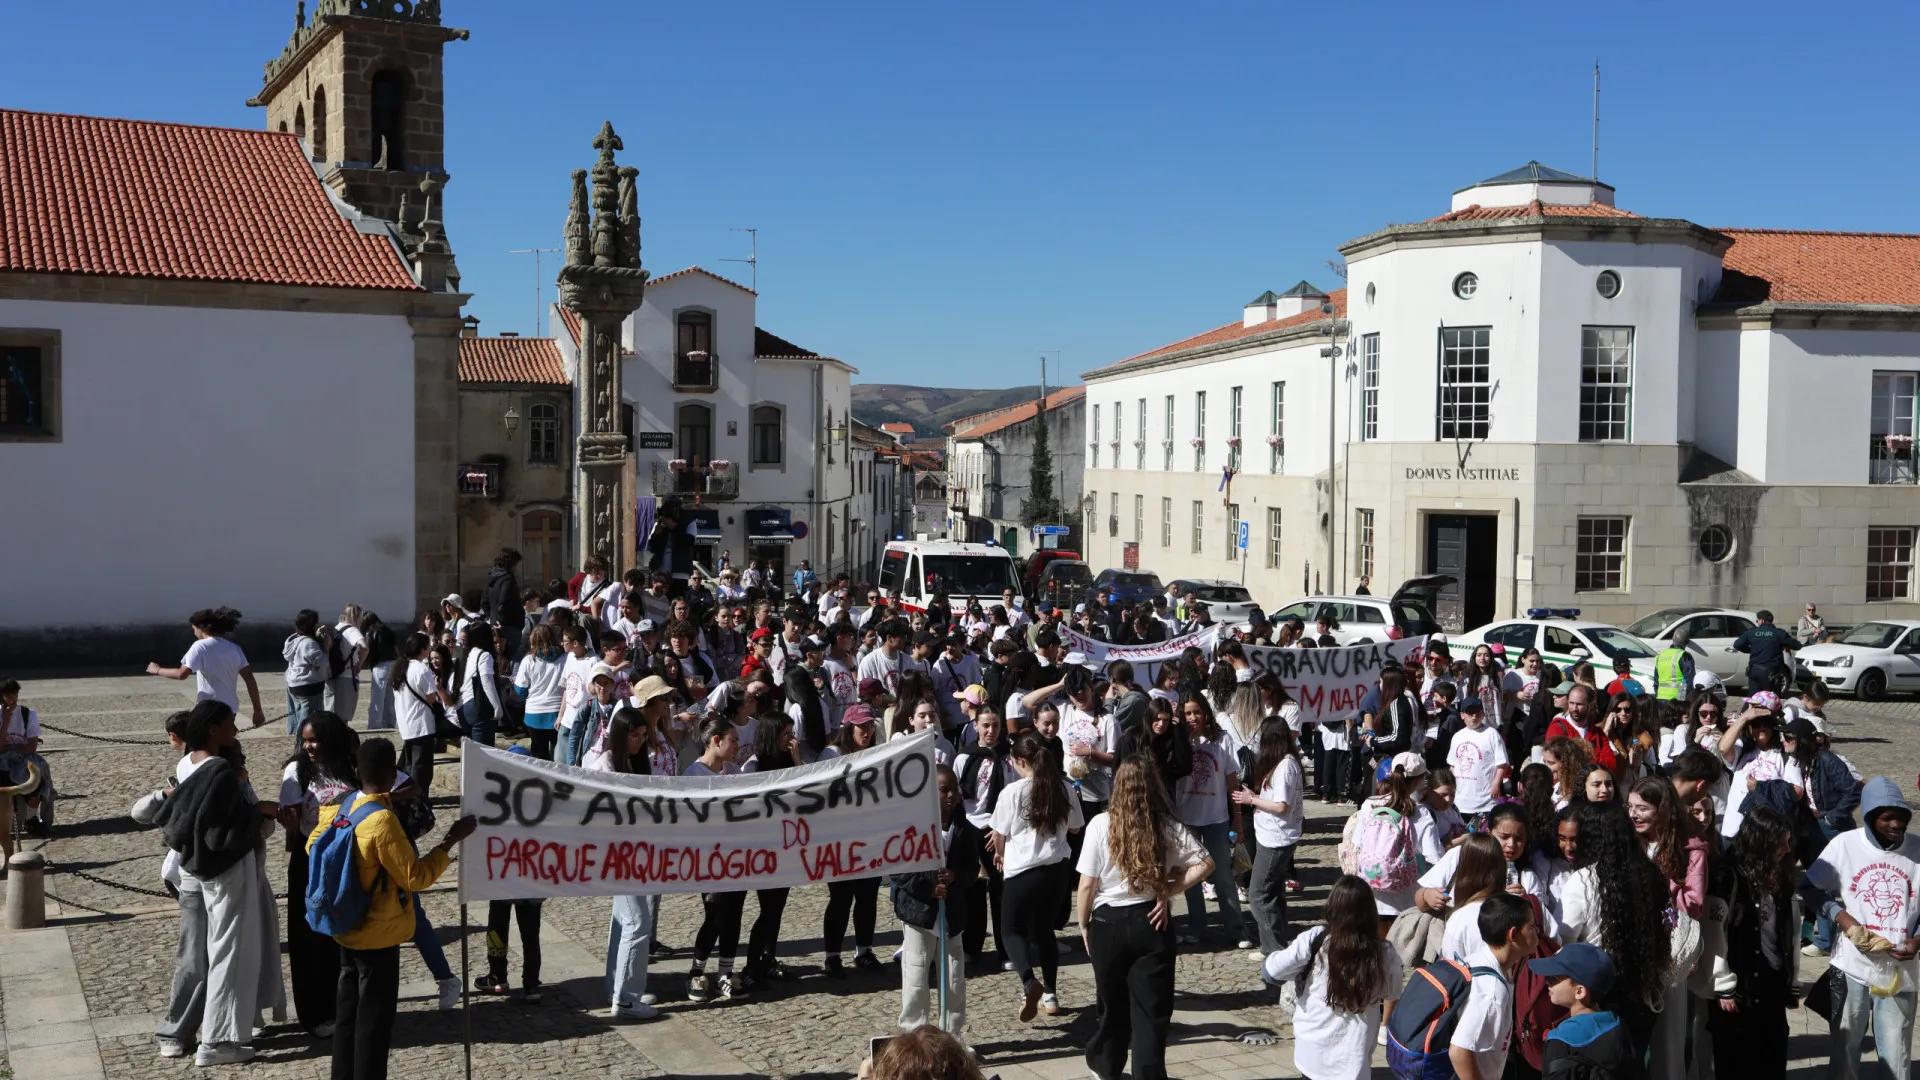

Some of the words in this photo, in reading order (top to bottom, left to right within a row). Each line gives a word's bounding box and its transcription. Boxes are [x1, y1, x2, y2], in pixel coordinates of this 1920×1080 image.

[1406, 467, 1451, 480] DOMVS
[579, 752, 930, 826] ANIVERSÁRIO
[487, 836, 597, 885] PARQUE
[600, 840, 778, 884] ARQUEOLÓGICO
[782, 817, 810, 850] DO
